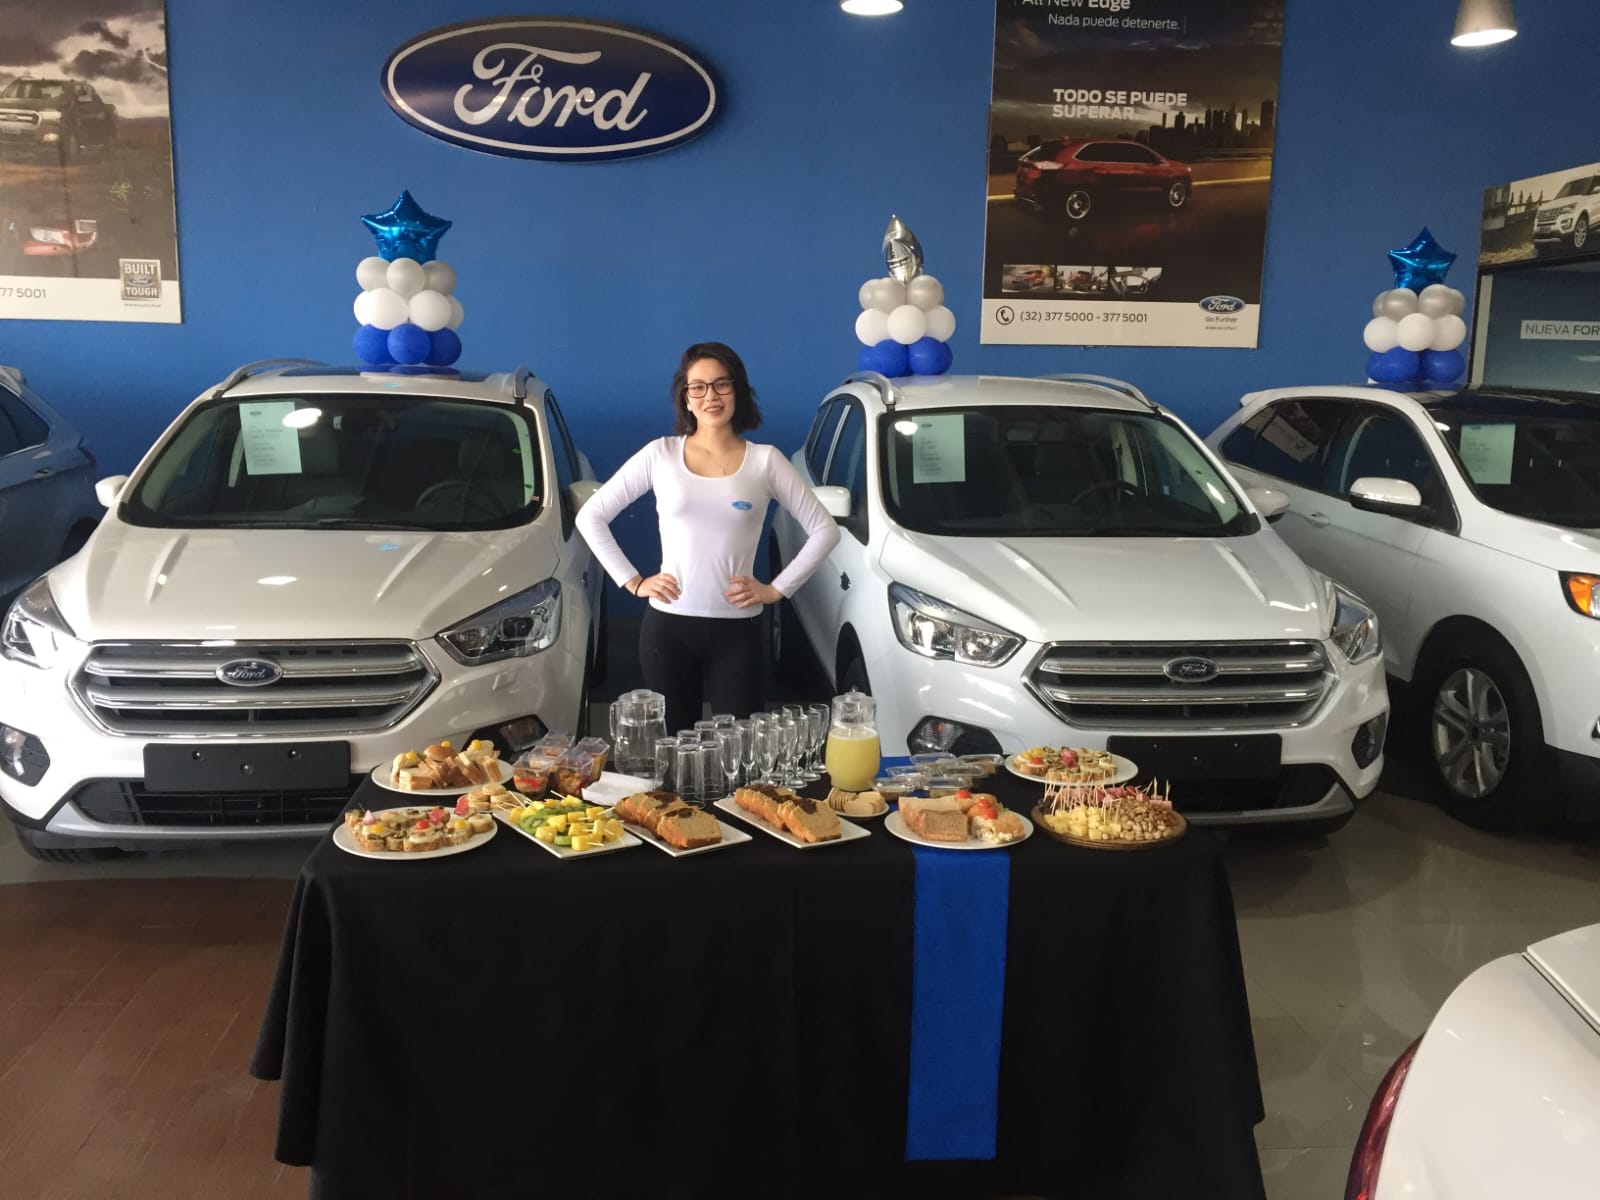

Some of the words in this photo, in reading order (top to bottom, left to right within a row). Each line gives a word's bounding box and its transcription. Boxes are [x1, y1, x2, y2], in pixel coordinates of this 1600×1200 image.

[1088, 0, 1131, 12] Edge
[1048, 13, 1080, 26] Nada
[1082, 15, 1120, 28] puede
[1121, 16, 1180, 30] detenerte.
[453, 42, 652, 131] Ford
[1052, 88, 1102, 104] TODO
[1104, 90, 1127, 105] SE
[1129, 91, 1188, 107] PUEDE
[124, 263, 156, 275] BUILT
[16, 287, 47, 298] 5001
[125, 286, 158, 297] TOUGH
[1207, 297, 1237, 311] Ford
[1020, 311, 1042, 323] (32)
[1044, 312, 1063, 322] 377
[1064, 312, 1094, 322] 5000
[1102, 313, 1121, 323] 377
[1122, 313, 1148, 323] 5001
[1525, 322, 1570, 335] NUEVA
[226, 662, 266, 679] Ford
